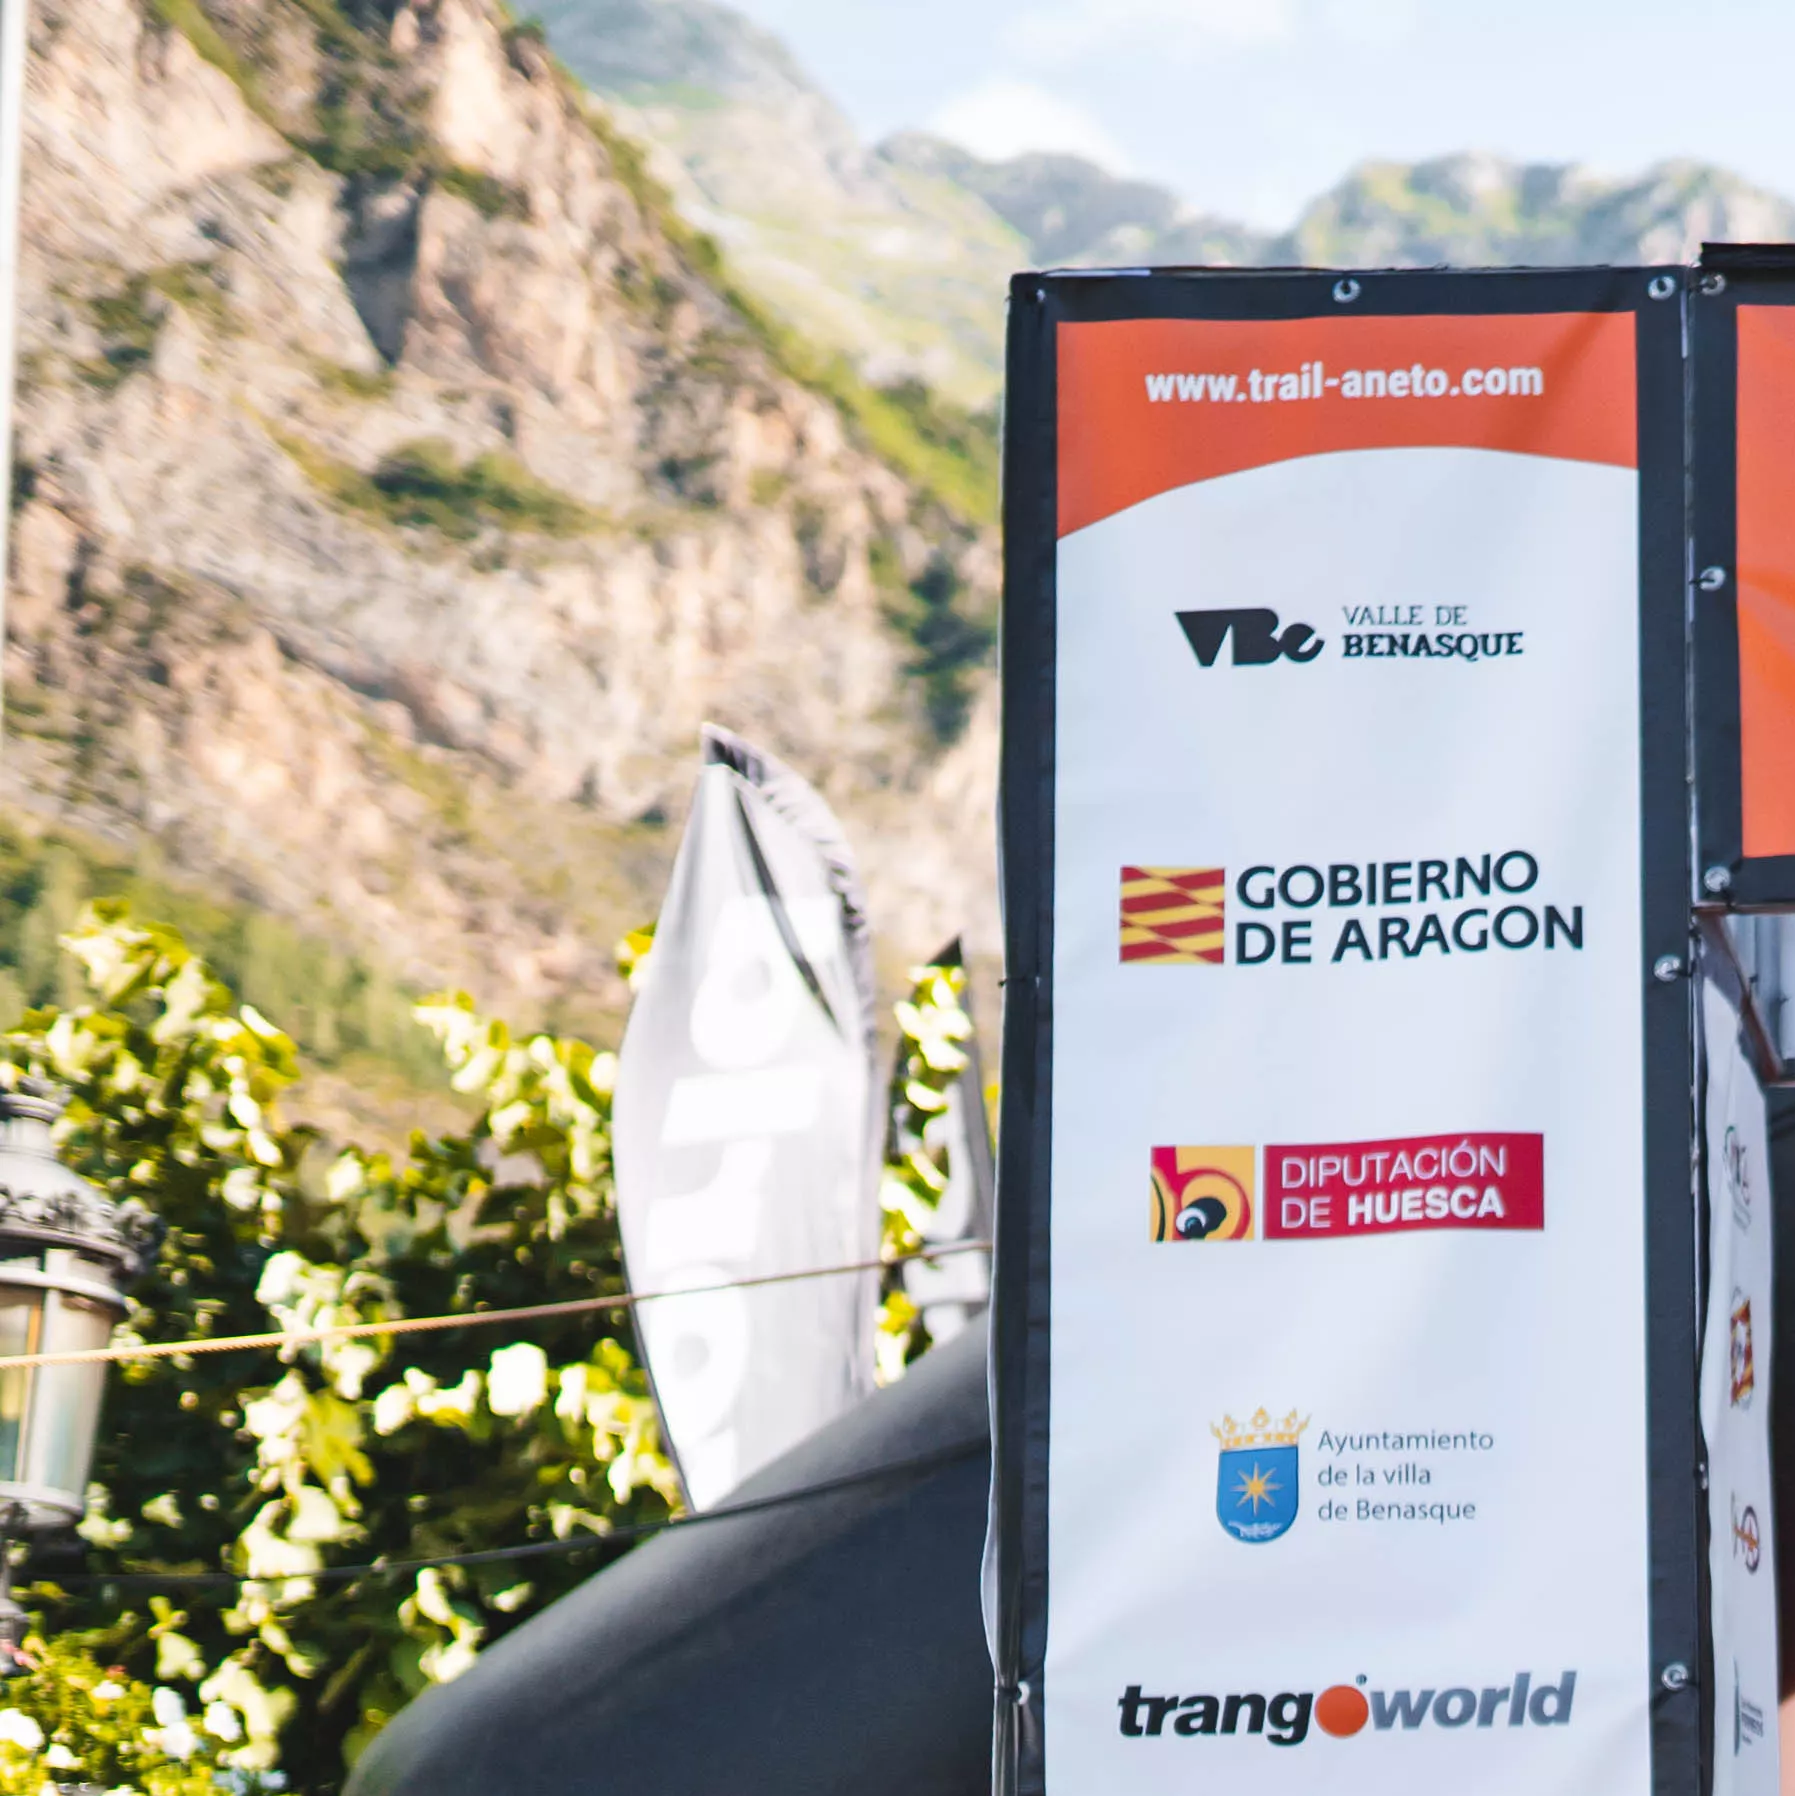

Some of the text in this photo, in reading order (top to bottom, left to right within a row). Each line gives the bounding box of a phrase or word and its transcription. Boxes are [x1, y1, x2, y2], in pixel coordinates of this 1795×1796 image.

[1145, 362, 1544, 402] www.trail-aneto.com
[1343, 606, 1467, 627] VALLE DE
[1343, 631, 1524, 662] BENASQUE
[1236, 850, 1538, 909] GOBIERNO
[1236, 905, 1583, 964] DE ARAGON
[1281, 1139, 1505, 1189] DIPUTACIÓN
[1281, 1185, 1504, 1229] DE HUESCA
[1318, 1429, 1494, 1455] Ayuntamiento
[1318, 1464, 1431, 1486] de la villa
[1318, 1499, 1476, 1525] de Benasque
[1118, 1670, 1576, 1747] trangoworld
